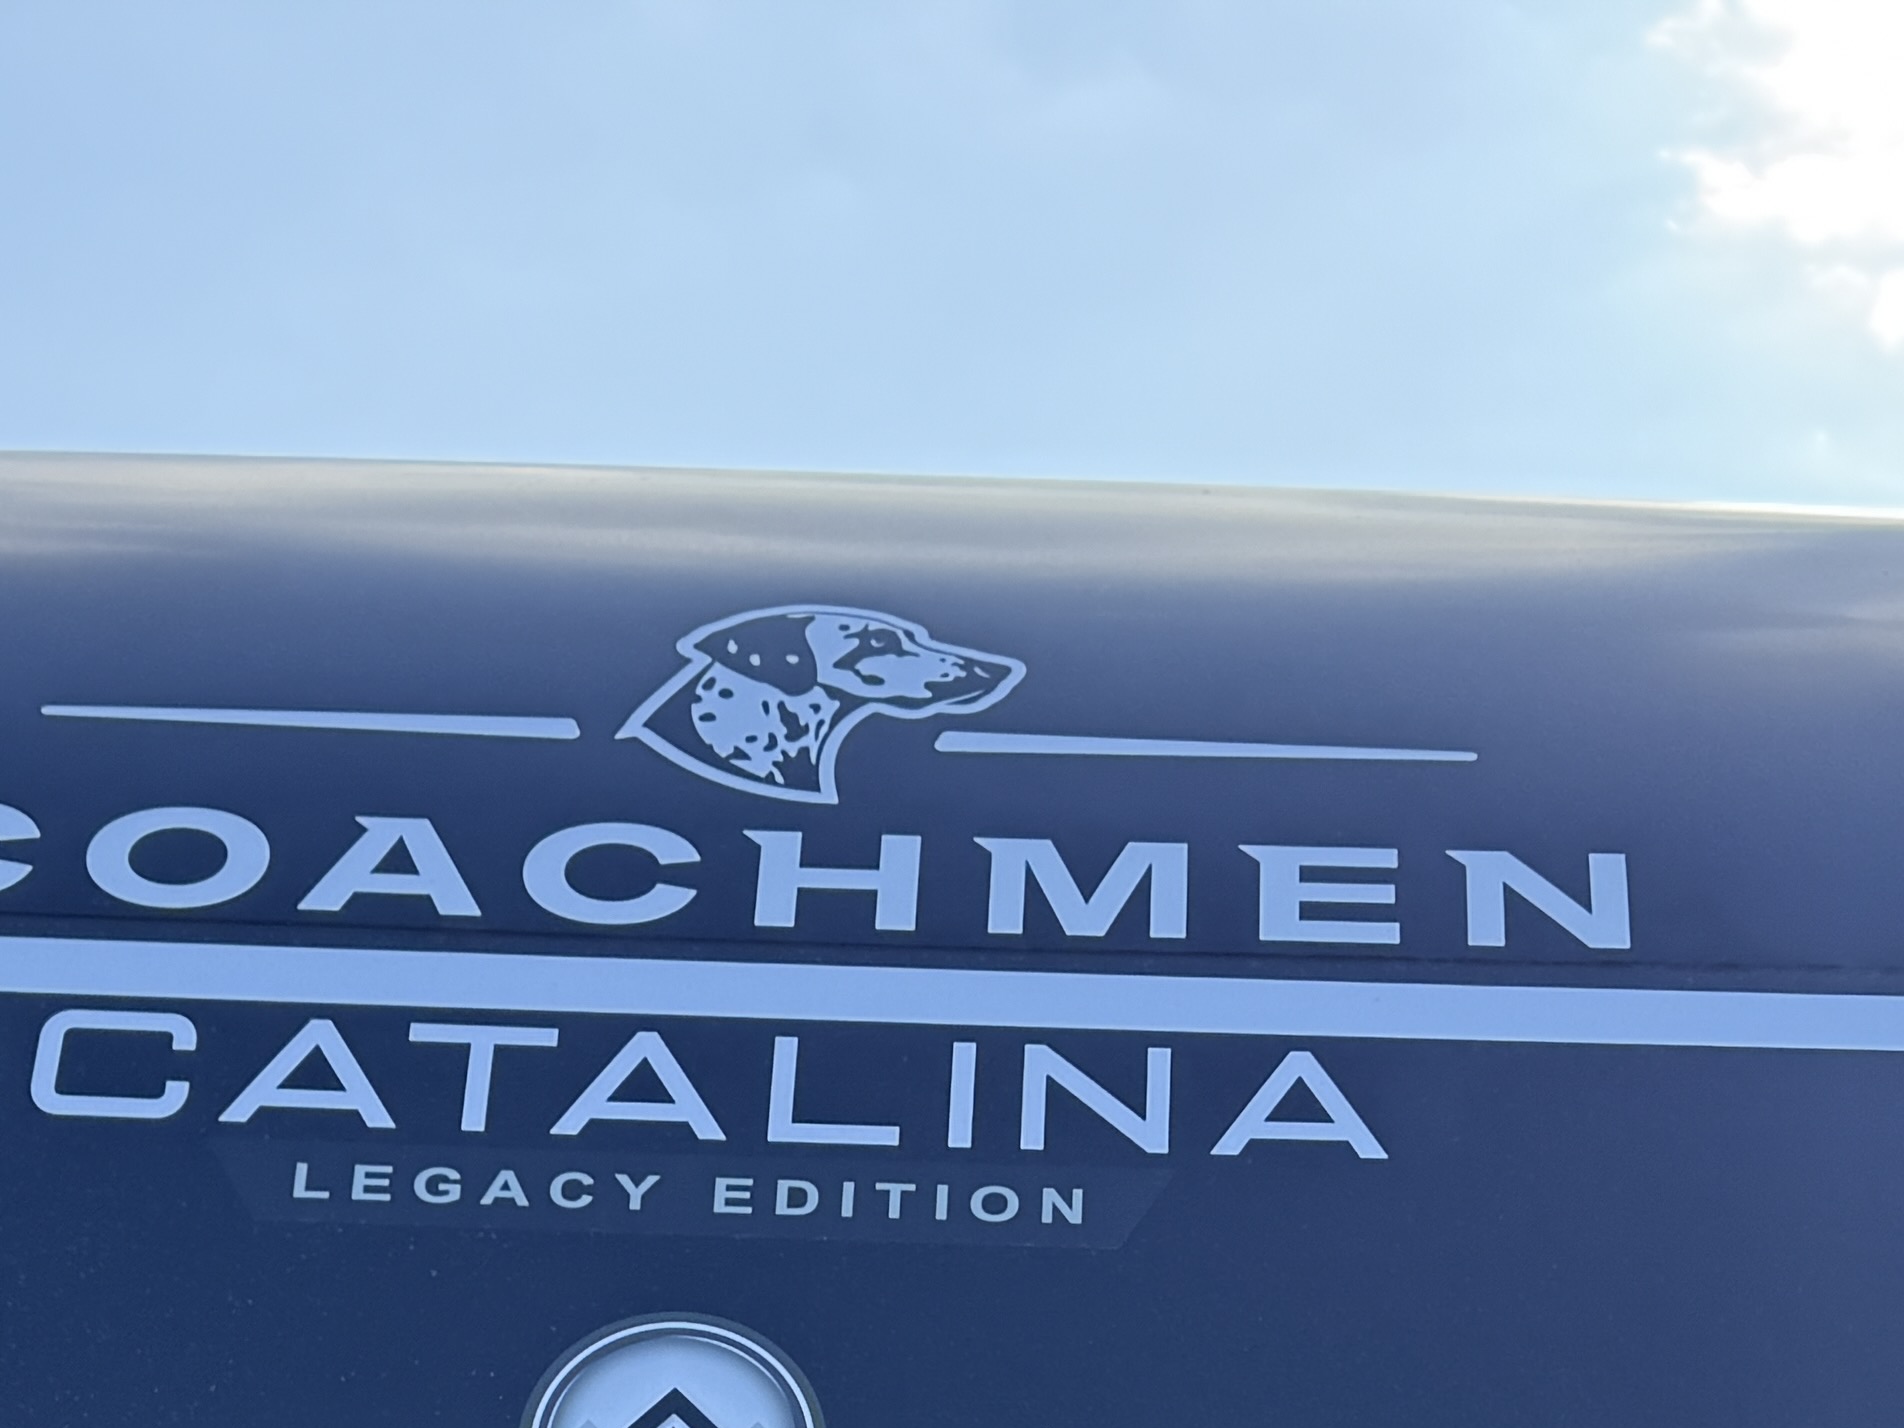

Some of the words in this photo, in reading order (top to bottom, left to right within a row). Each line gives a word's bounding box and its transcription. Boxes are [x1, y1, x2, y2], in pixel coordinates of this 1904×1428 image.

[28, 1010, 1390, 1161] CATALINA
[291, 1160, 663, 1215] LEGACY
[713, 1175, 1090, 1228] EDITION
